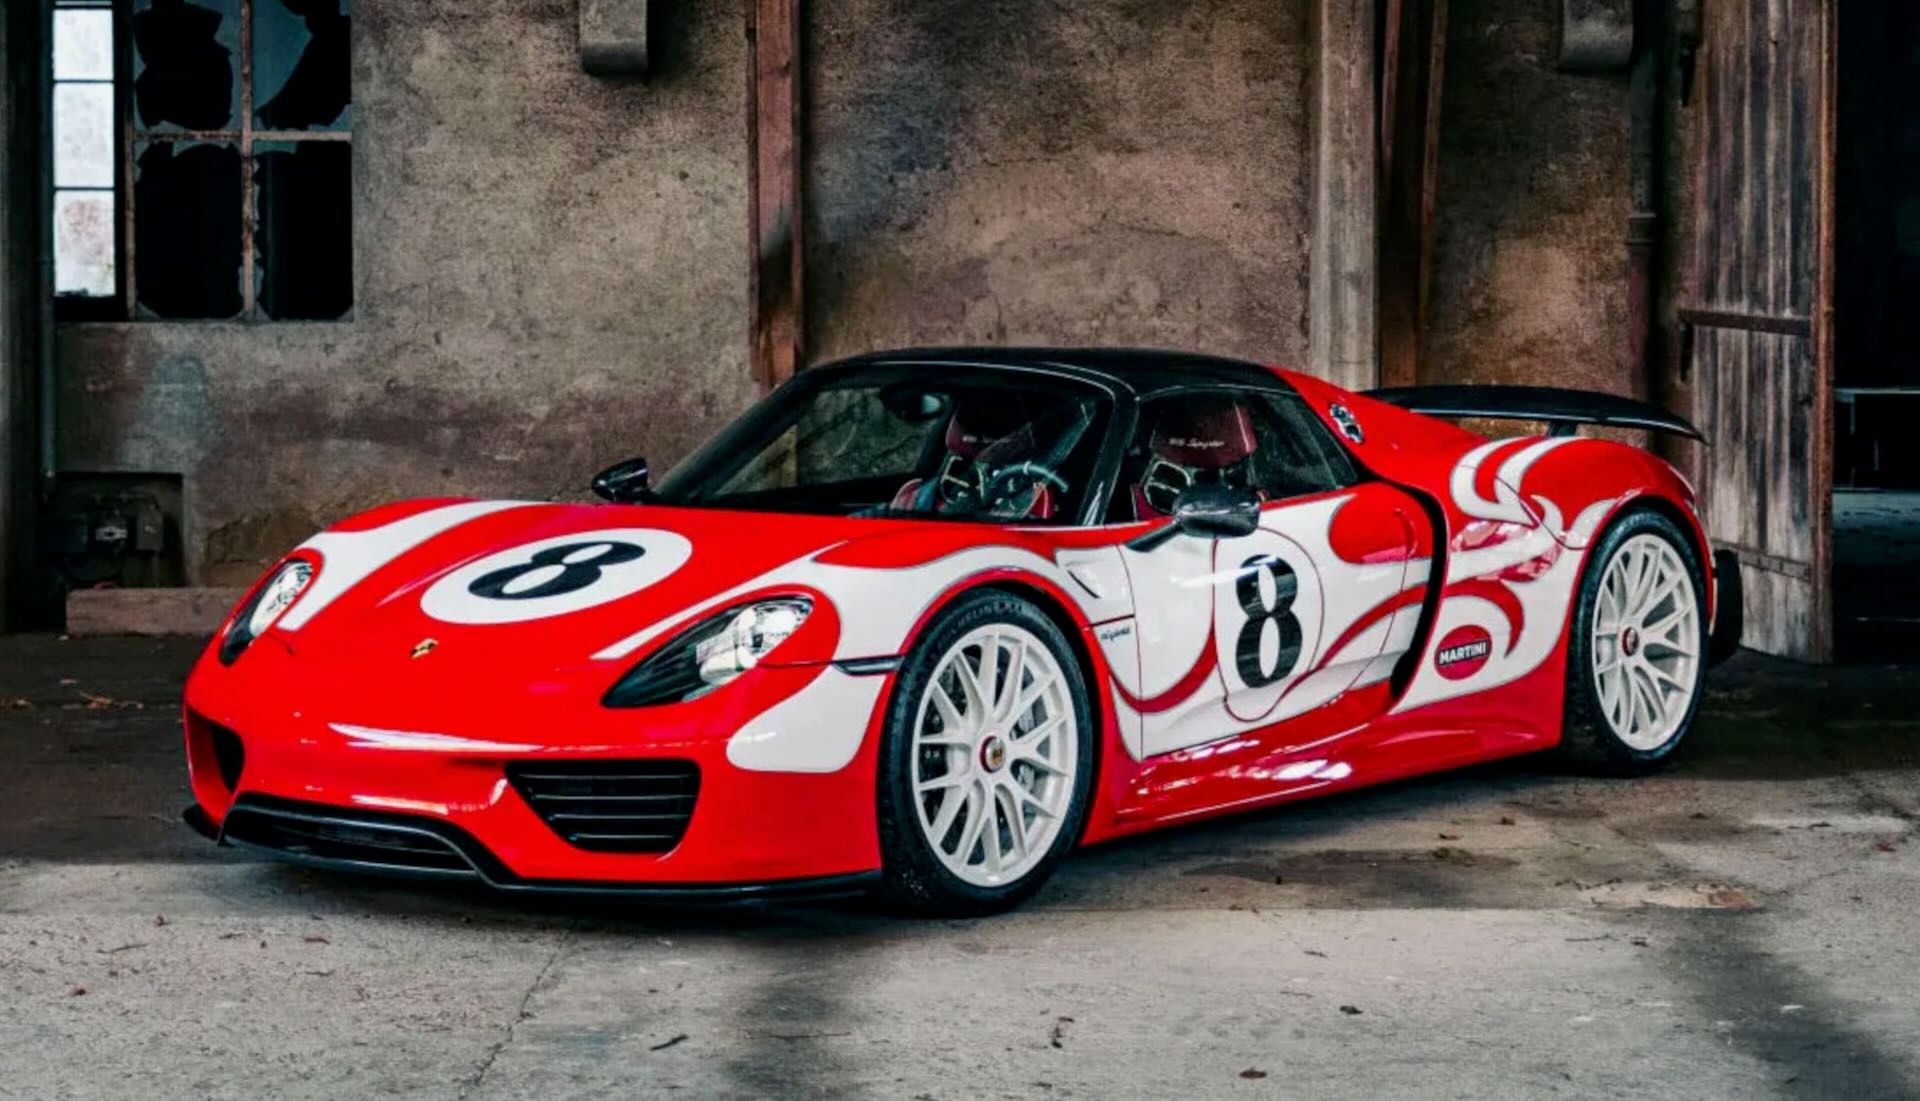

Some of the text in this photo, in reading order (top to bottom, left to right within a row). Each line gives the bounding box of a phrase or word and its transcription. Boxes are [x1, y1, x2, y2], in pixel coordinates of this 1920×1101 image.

[468, 541, 646, 600] 8
[1236, 554, 1303, 689] 8
[1439, 641, 1487, 665] MARTINI
